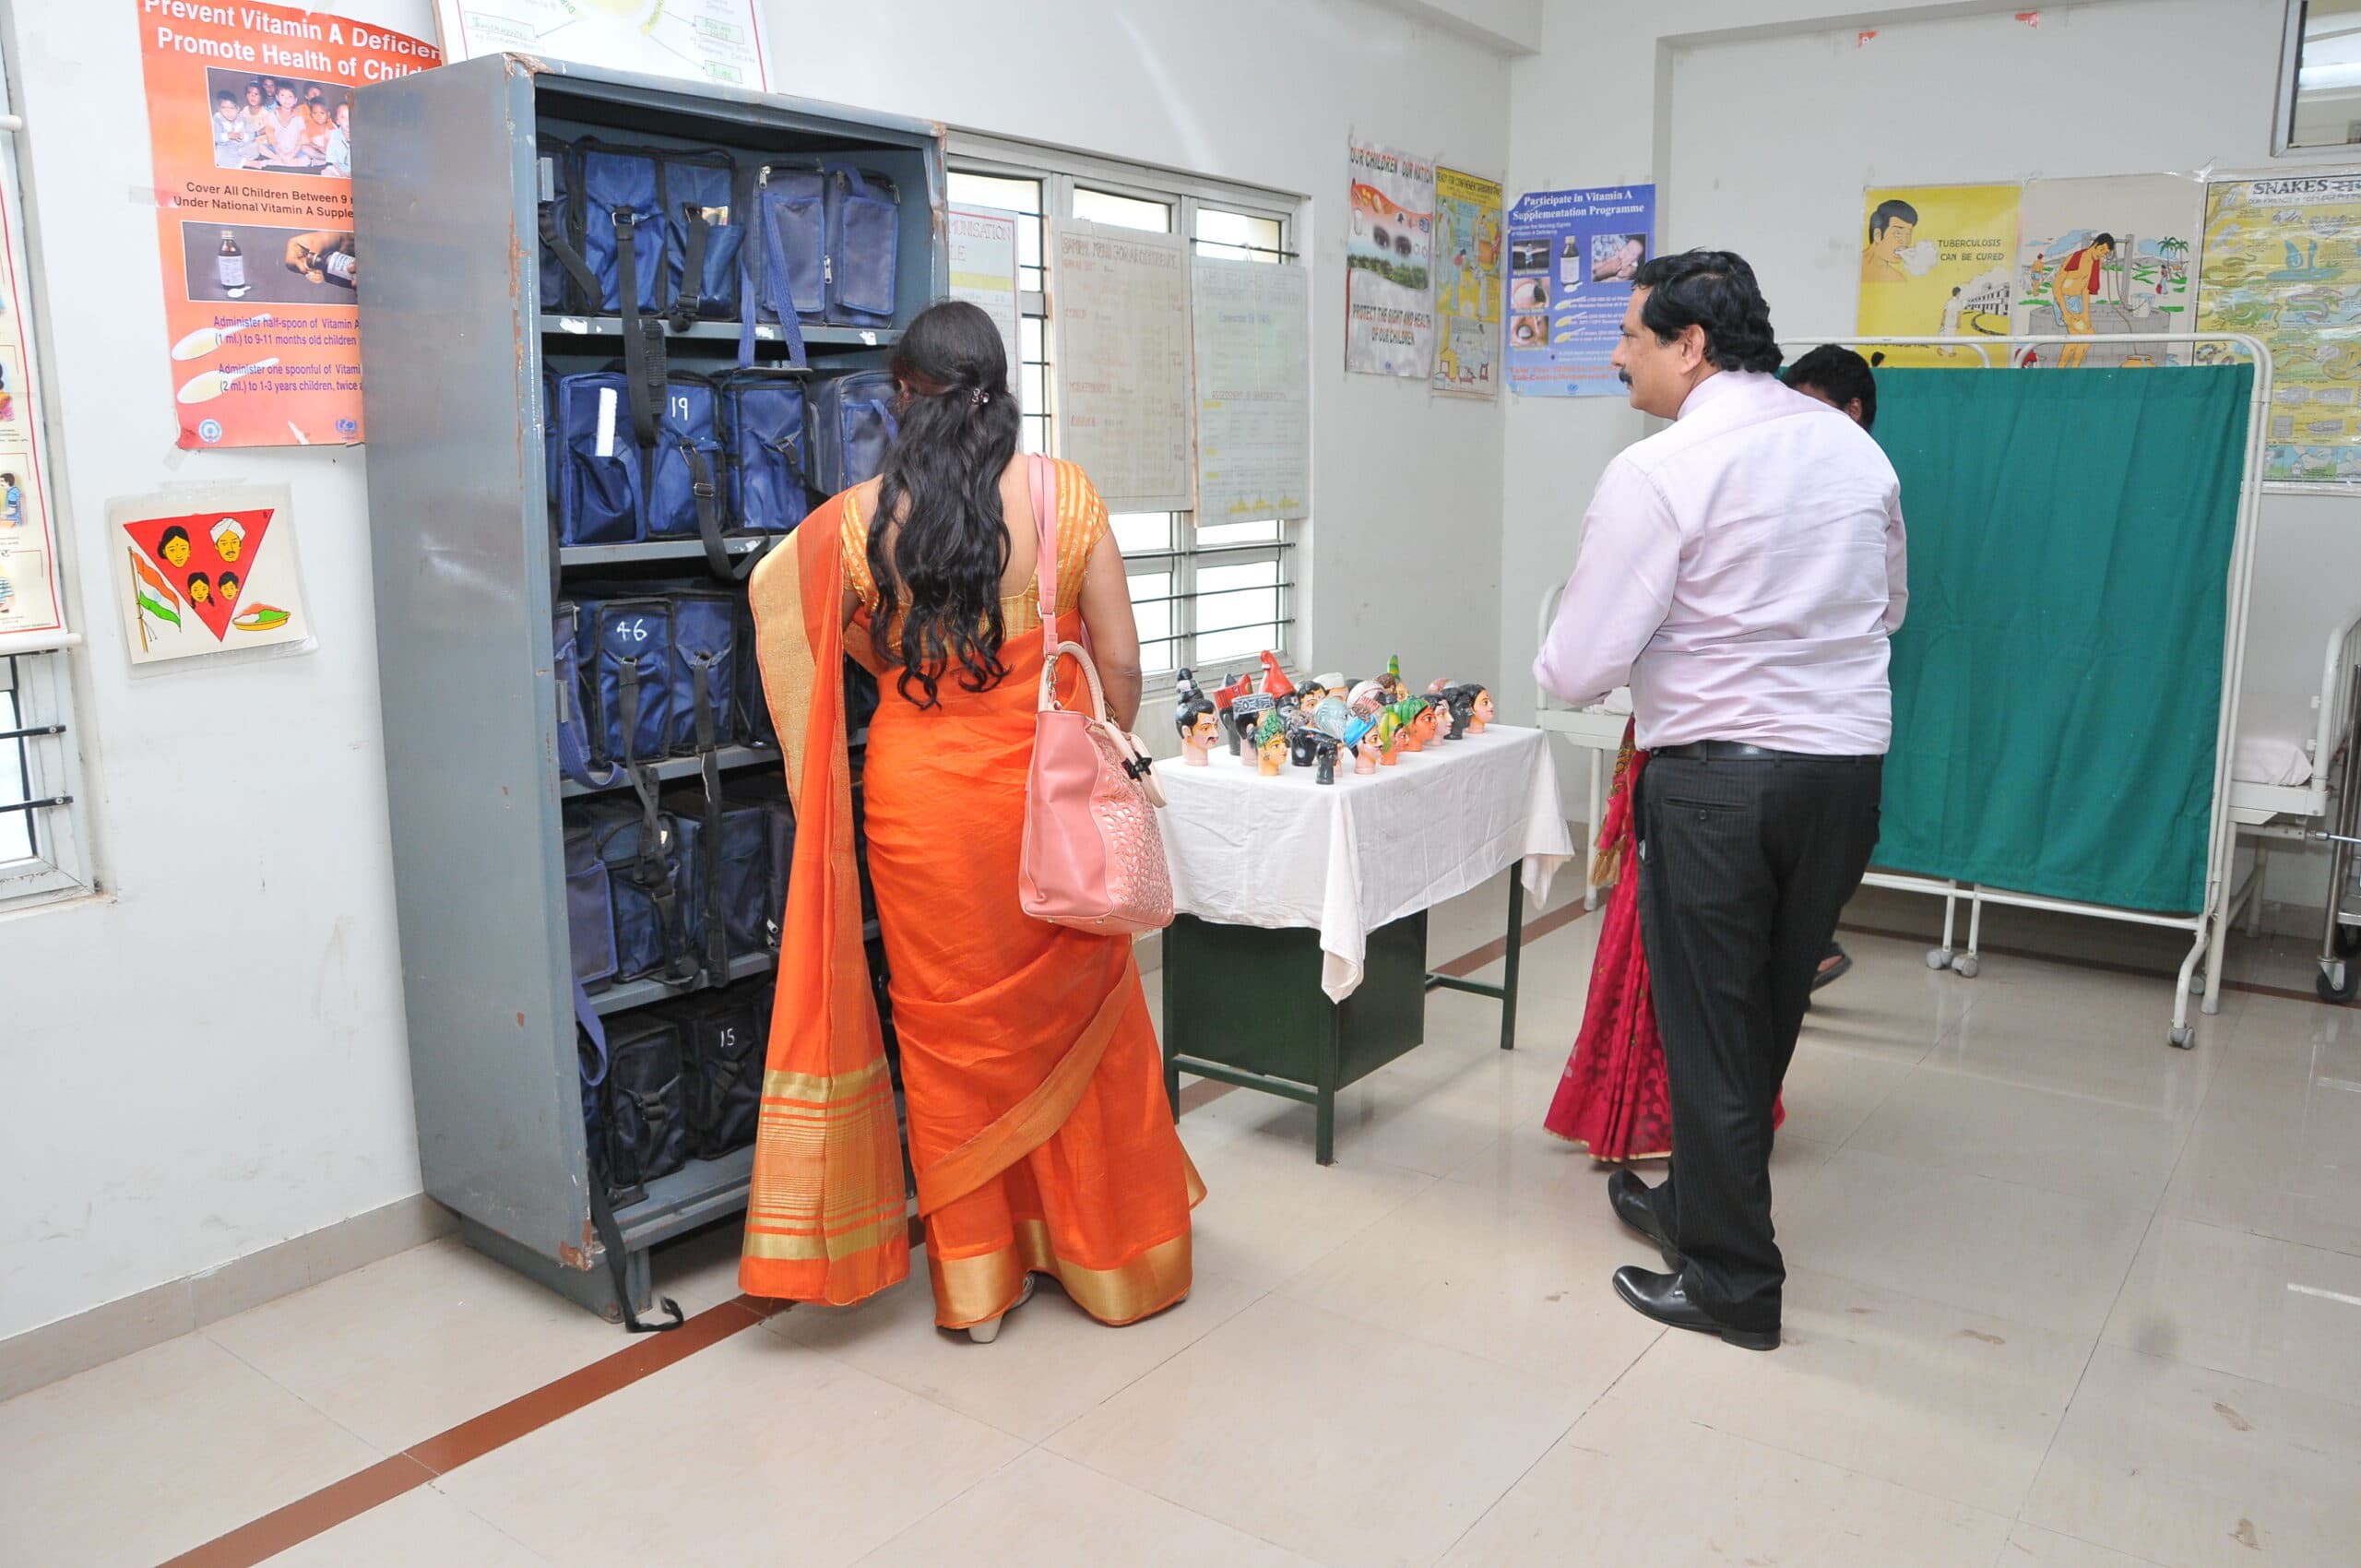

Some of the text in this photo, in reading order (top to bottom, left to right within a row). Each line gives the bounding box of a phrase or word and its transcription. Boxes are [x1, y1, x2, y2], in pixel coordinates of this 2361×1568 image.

[144, 0, 236, 27] Prevent
[241, 7, 322, 41] Vitamin
[329, 24, 344, 45] A
[157, 26, 256, 62] Promote
[262, 43, 332, 73] Health
[338, 57, 357, 77] of
[1350, 148, 1364, 167] OUR
[1366, 149, 1397, 173] CHILDREN
[186, 182, 220, 194] Cover
[224, 184, 239, 196] All
[242, 186, 289, 200] Children
[292, 191, 338, 204] Between
[340, 195, 348, 204] 9
[2252, 179, 2328, 195] SNAKES
[173, 196, 208, 208] Under
[212, 198, 258, 212] National
[262, 203, 303, 215] Vitamin
[306, 207, 314, 215] A
[1524, 190, 1632, 208] Participate in Vitamin A
[1513, 205, 1645, 222] Supplementation Programme
[1938, 239, 2001, 247] TUBERCULOSIS
[1940, 253, 2004, 261] CAN BE CURED
[213, 315, 261, 327] Administer
[263, 316, 310, 331] half-spoon
[310, 318, 318, 328] of
[322, 318, 352, 329] Vitamin
[1353, 303, 1376, 321] PROTECT
[1378, 306, 1387, 323] THE
[1388, 308, 1403, 324] SIGHT
[1404, 310, 1414, 326] AND
[215, 333, 357, 347] (1 ml.) to 9-11 months old children
[1372, 326, 1416, 346] OF OUR CHILDREN
[219, 363, 265, 374] Administer
[267, 365, 283, 374] one
[285, 363, 322, 377] spoonful
[324, 363, 332, 374] of
[219, 380, 229, 392] (2
[231, 380, 247, 393] ml.)
[248, 381, 257, 391] to
[260, 381, 272, 391] 1-3
[275, 383, 297, 394] years
[337, 381, 358, 391] twice
[671, 396, 688, 422] 19
[616, 618, 647, 641] 46
[720, 1028, 735, 1048] 15
